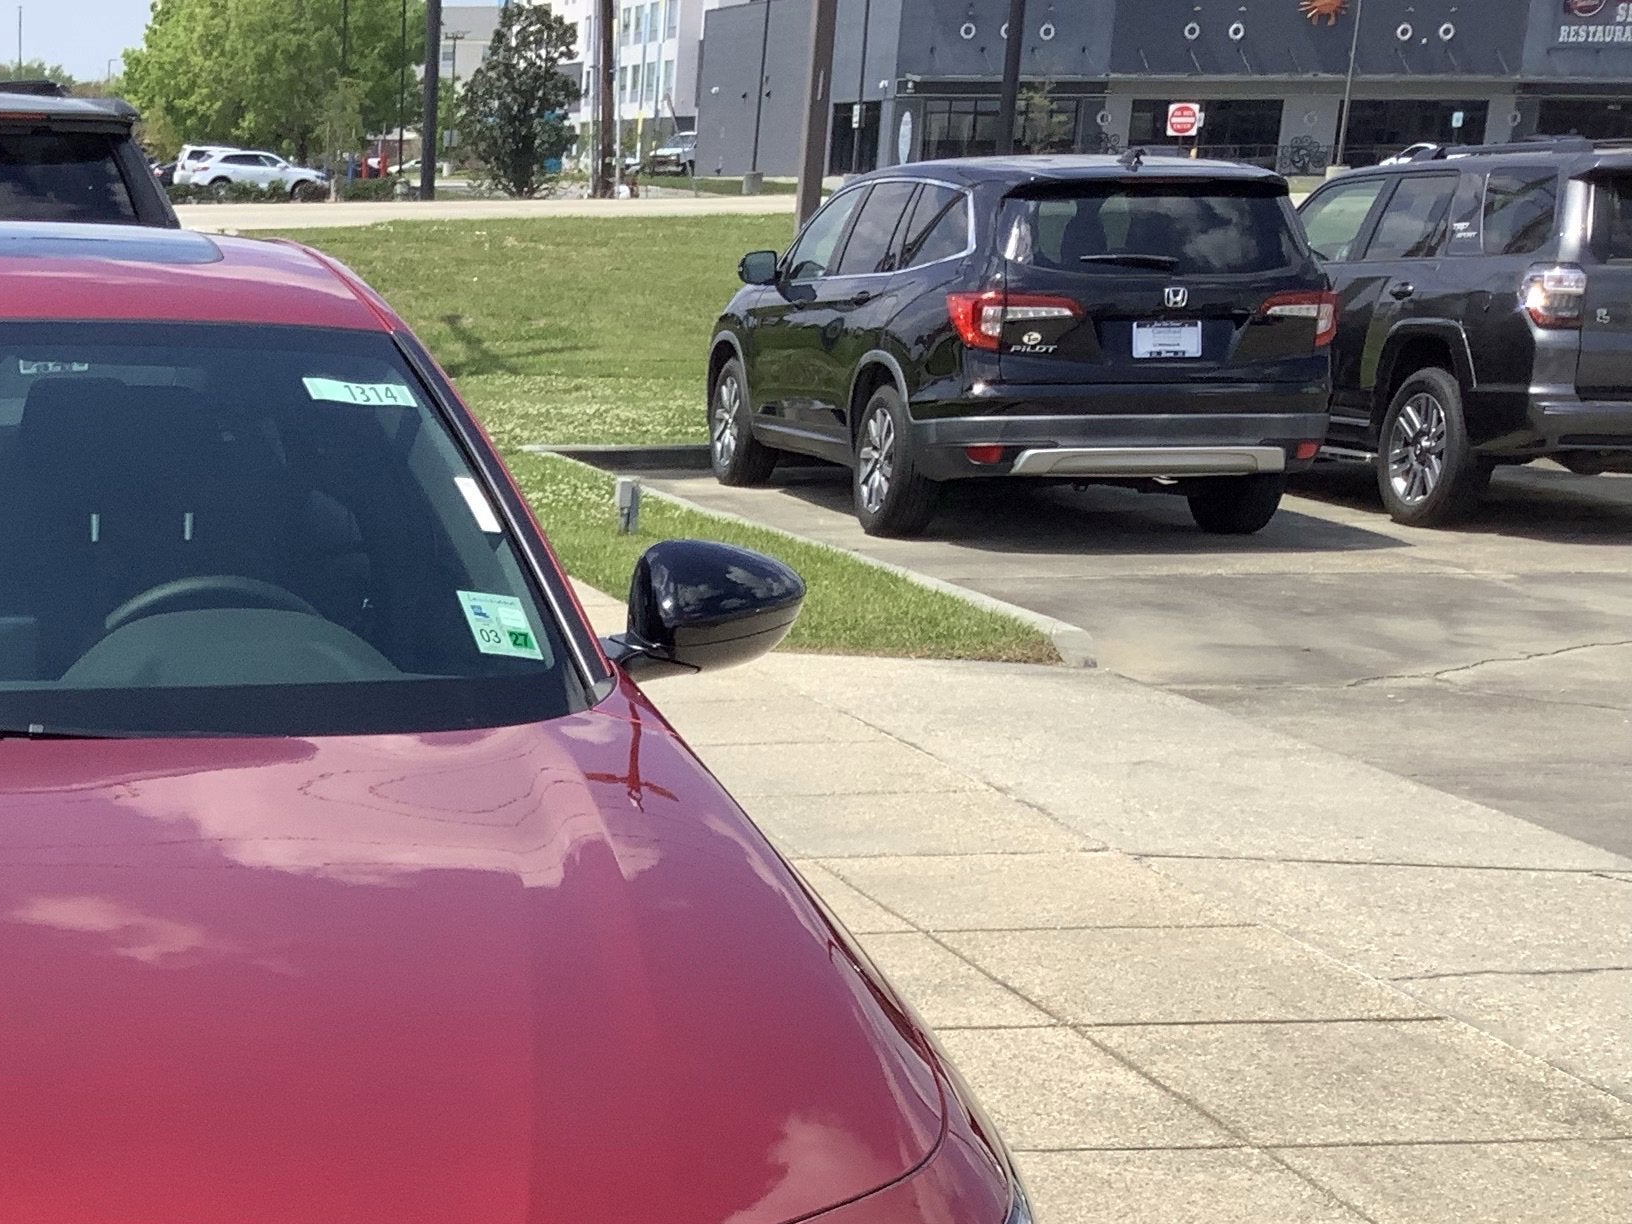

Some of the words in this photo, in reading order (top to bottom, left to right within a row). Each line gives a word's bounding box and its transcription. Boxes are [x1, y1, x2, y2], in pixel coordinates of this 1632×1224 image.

[1010, 344, 1058, 353] PILOT
[343, 385, 398, 403] 1314
[479, 628, 502, 644] 03
[509, 631, 529, 648] 27
